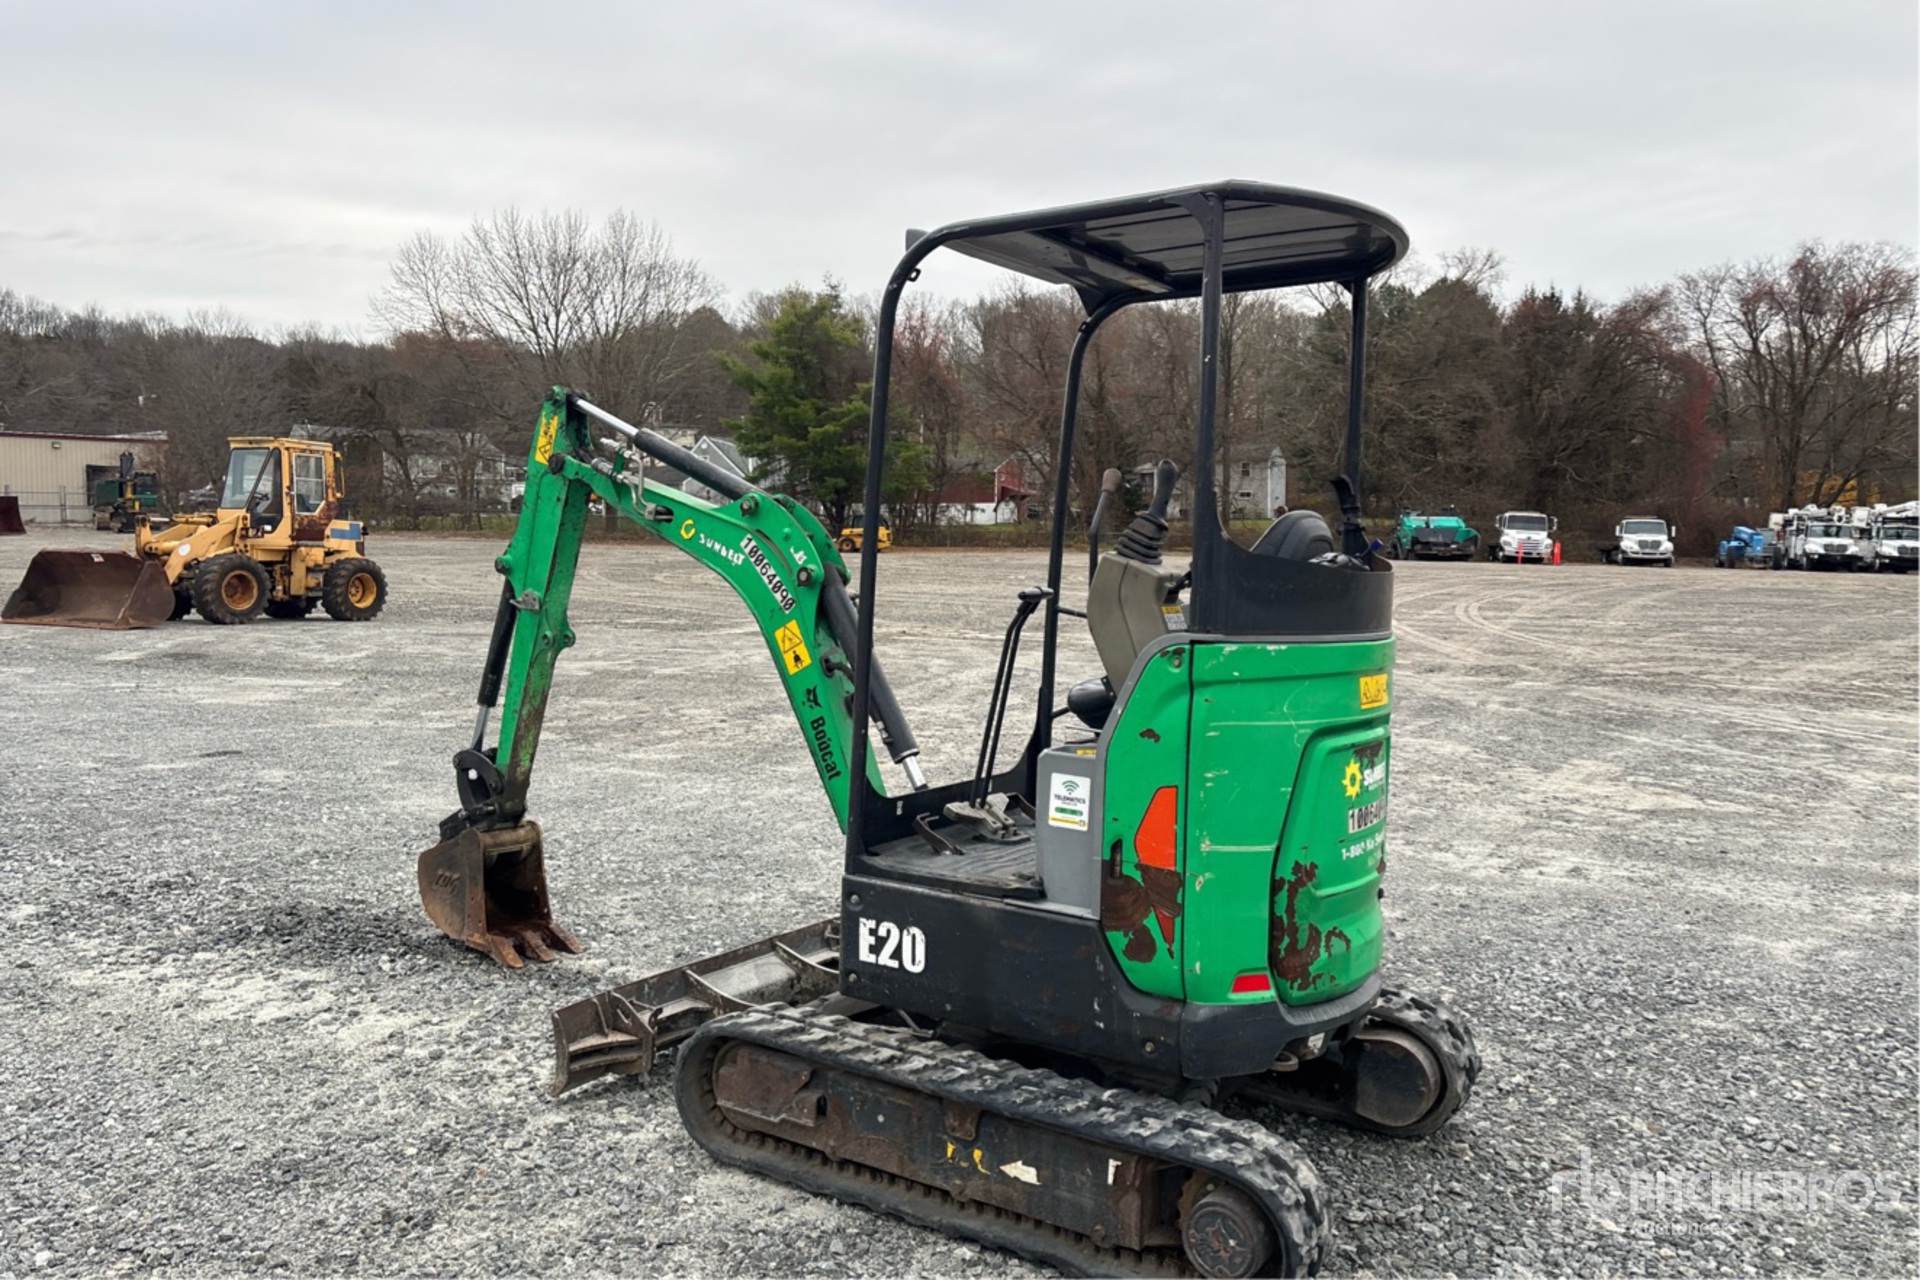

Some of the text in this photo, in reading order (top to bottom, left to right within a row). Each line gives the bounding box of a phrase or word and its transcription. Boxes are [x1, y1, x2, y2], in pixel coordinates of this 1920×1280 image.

[743, 536, 796, 612] 10064090
[810, 715, 842, 781] Bobcat
[859, 917, 926, 974] E20
